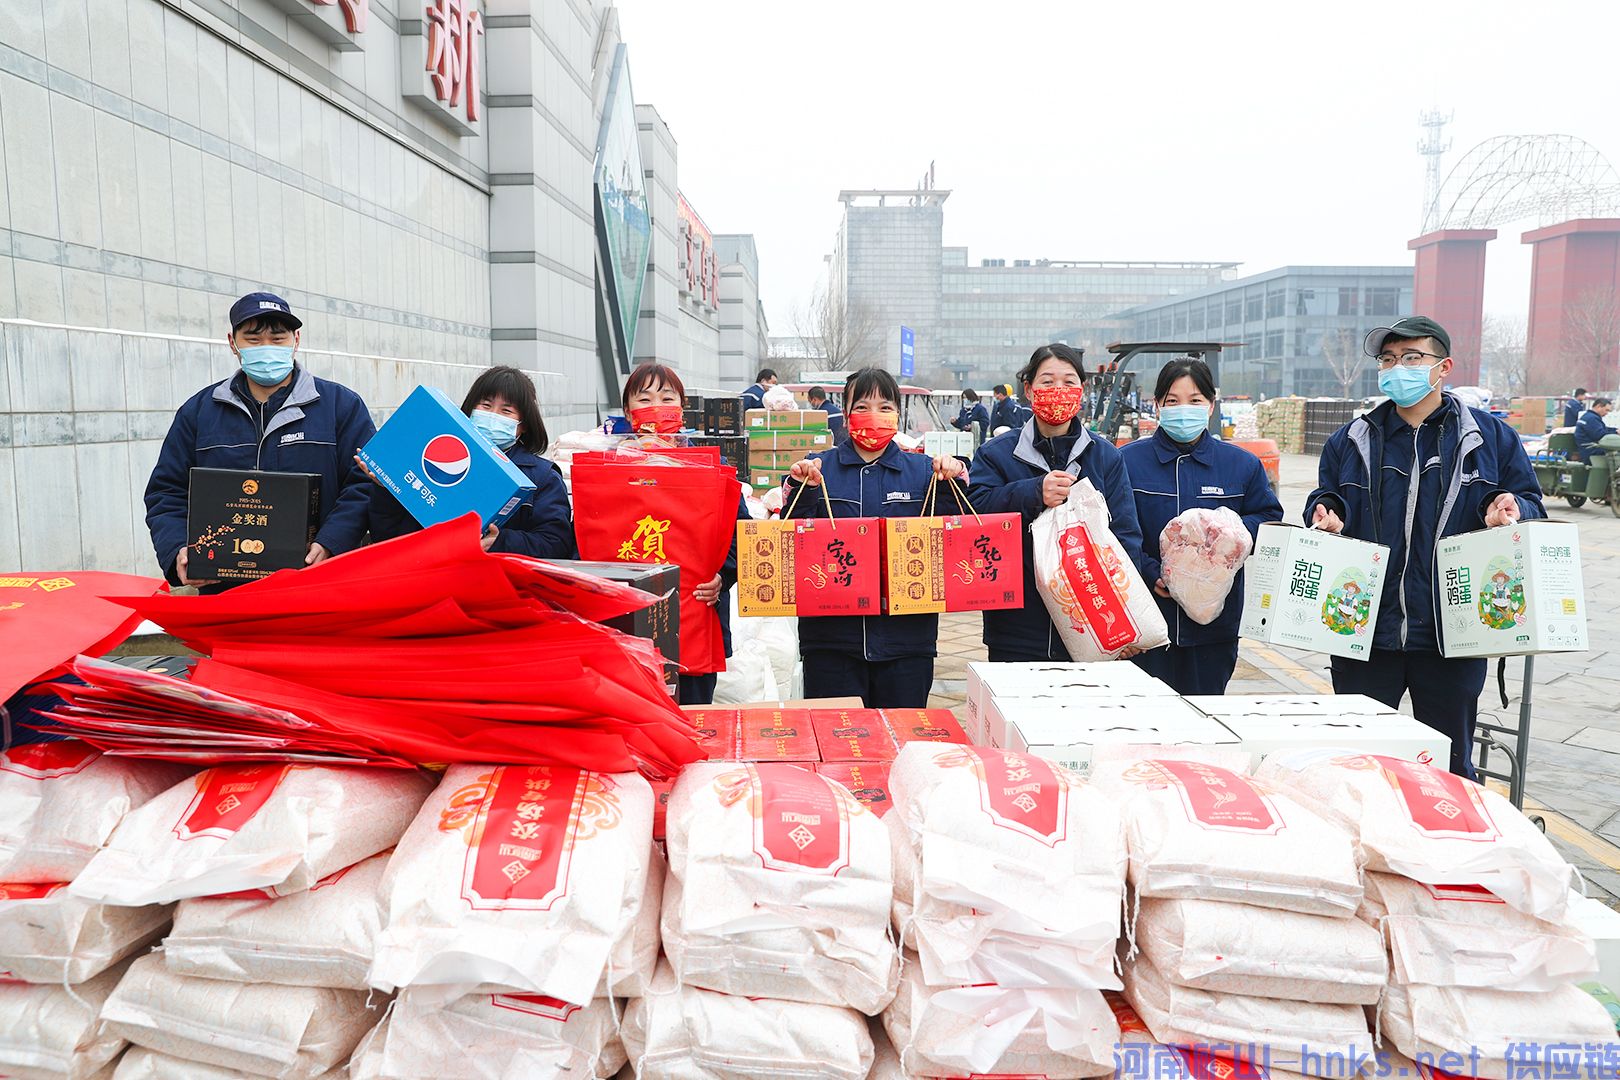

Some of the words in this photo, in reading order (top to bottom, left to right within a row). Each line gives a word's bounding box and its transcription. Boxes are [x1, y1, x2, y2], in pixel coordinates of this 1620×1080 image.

[403, 469, 438, 507] 百事可乐
[231, 512, 269, 526] 金奖酒
[1292, 558, 1323, 581] 京白
[1445, 565, 1471, 587] 京白
[1073, 556, 1108, 611] 农场专供
[1289, 577, 1321, 601] 鸡蛋
[1447, 584, 1472, 607] 鸡蛋
